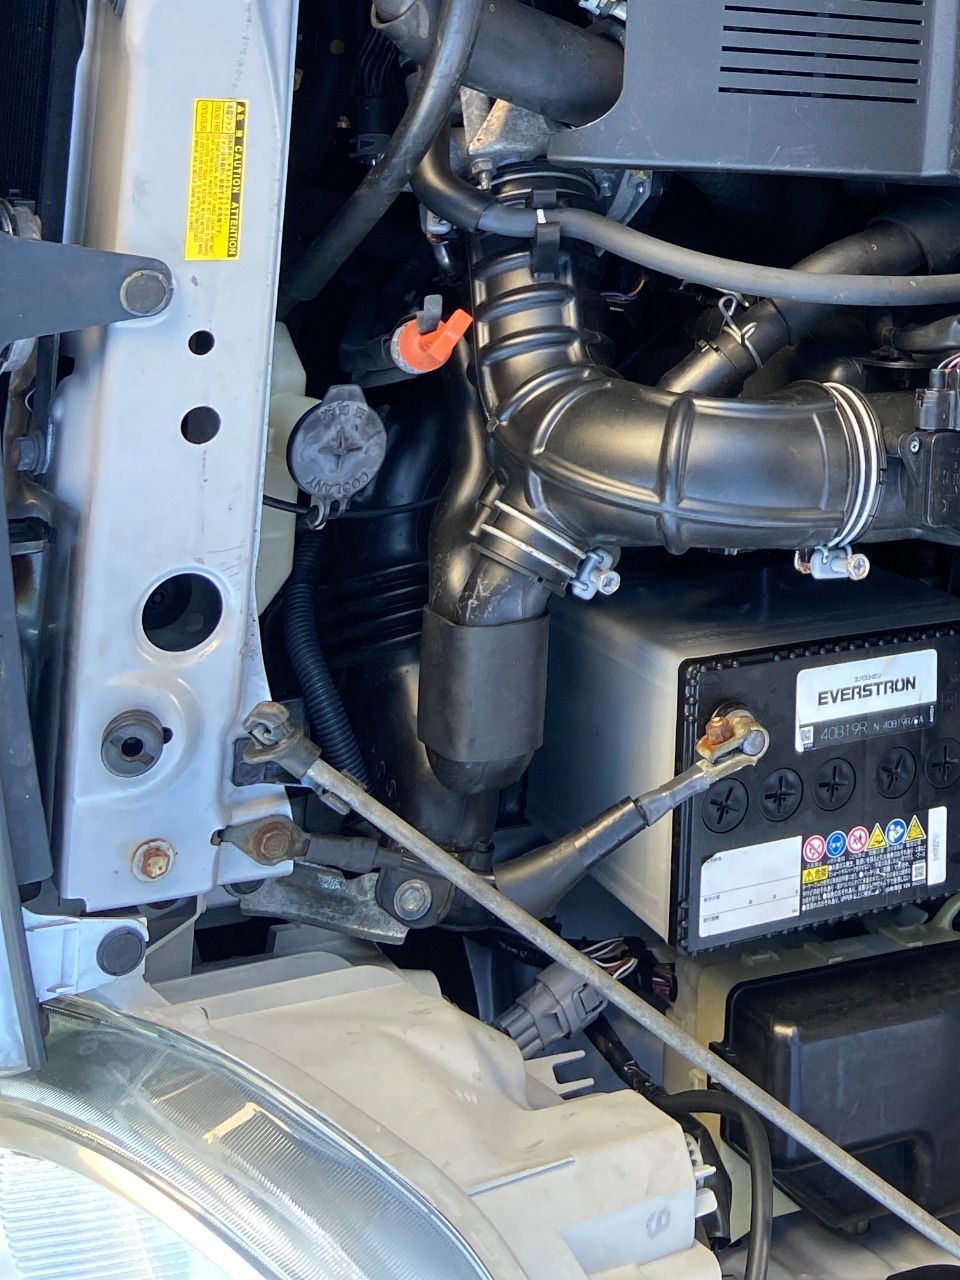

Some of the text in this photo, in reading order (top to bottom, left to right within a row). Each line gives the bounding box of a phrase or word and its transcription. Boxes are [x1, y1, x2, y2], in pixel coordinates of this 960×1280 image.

[228, 145, 242, 254] CAUTION ATTENTION
[305, 471, 369, 494] COOLANT
[818, 676, 916, 706] EVERSTRON
[820, 721, 868, 741] 40B19R
